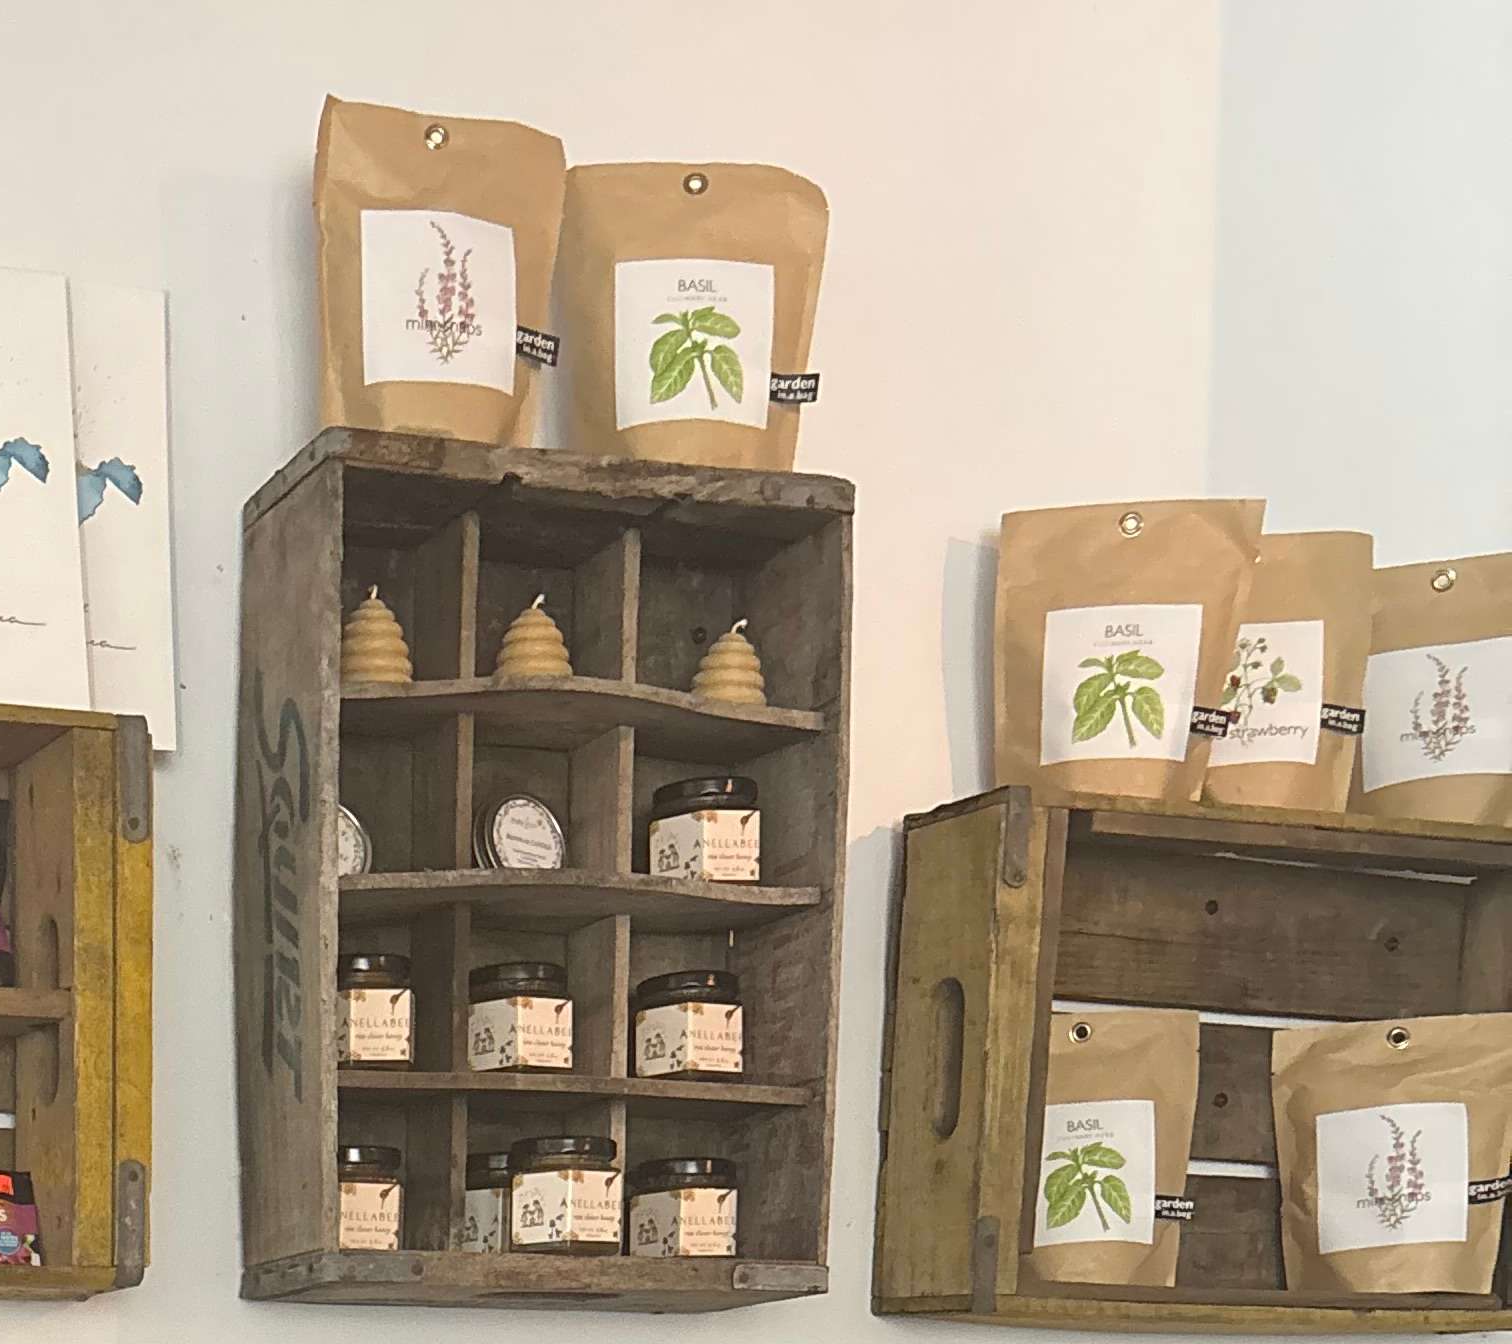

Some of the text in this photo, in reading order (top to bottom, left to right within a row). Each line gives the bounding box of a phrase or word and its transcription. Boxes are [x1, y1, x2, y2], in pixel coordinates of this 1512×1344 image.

[677, 279, 717, 293] BASIL
[517, 330, 555, 350] garden
[770, 376, 816, 391] garden
[1104, 623, 1144, 638] BASIL
[1191, 710, 1227, 726] garden
[1320, 706, 1361, 722] garden
[1229, 723, 1310, 738] strawberry
[1066, 1119, 1104, 1133] BASIL
[1155, 1198, 1195, 1210] garden
